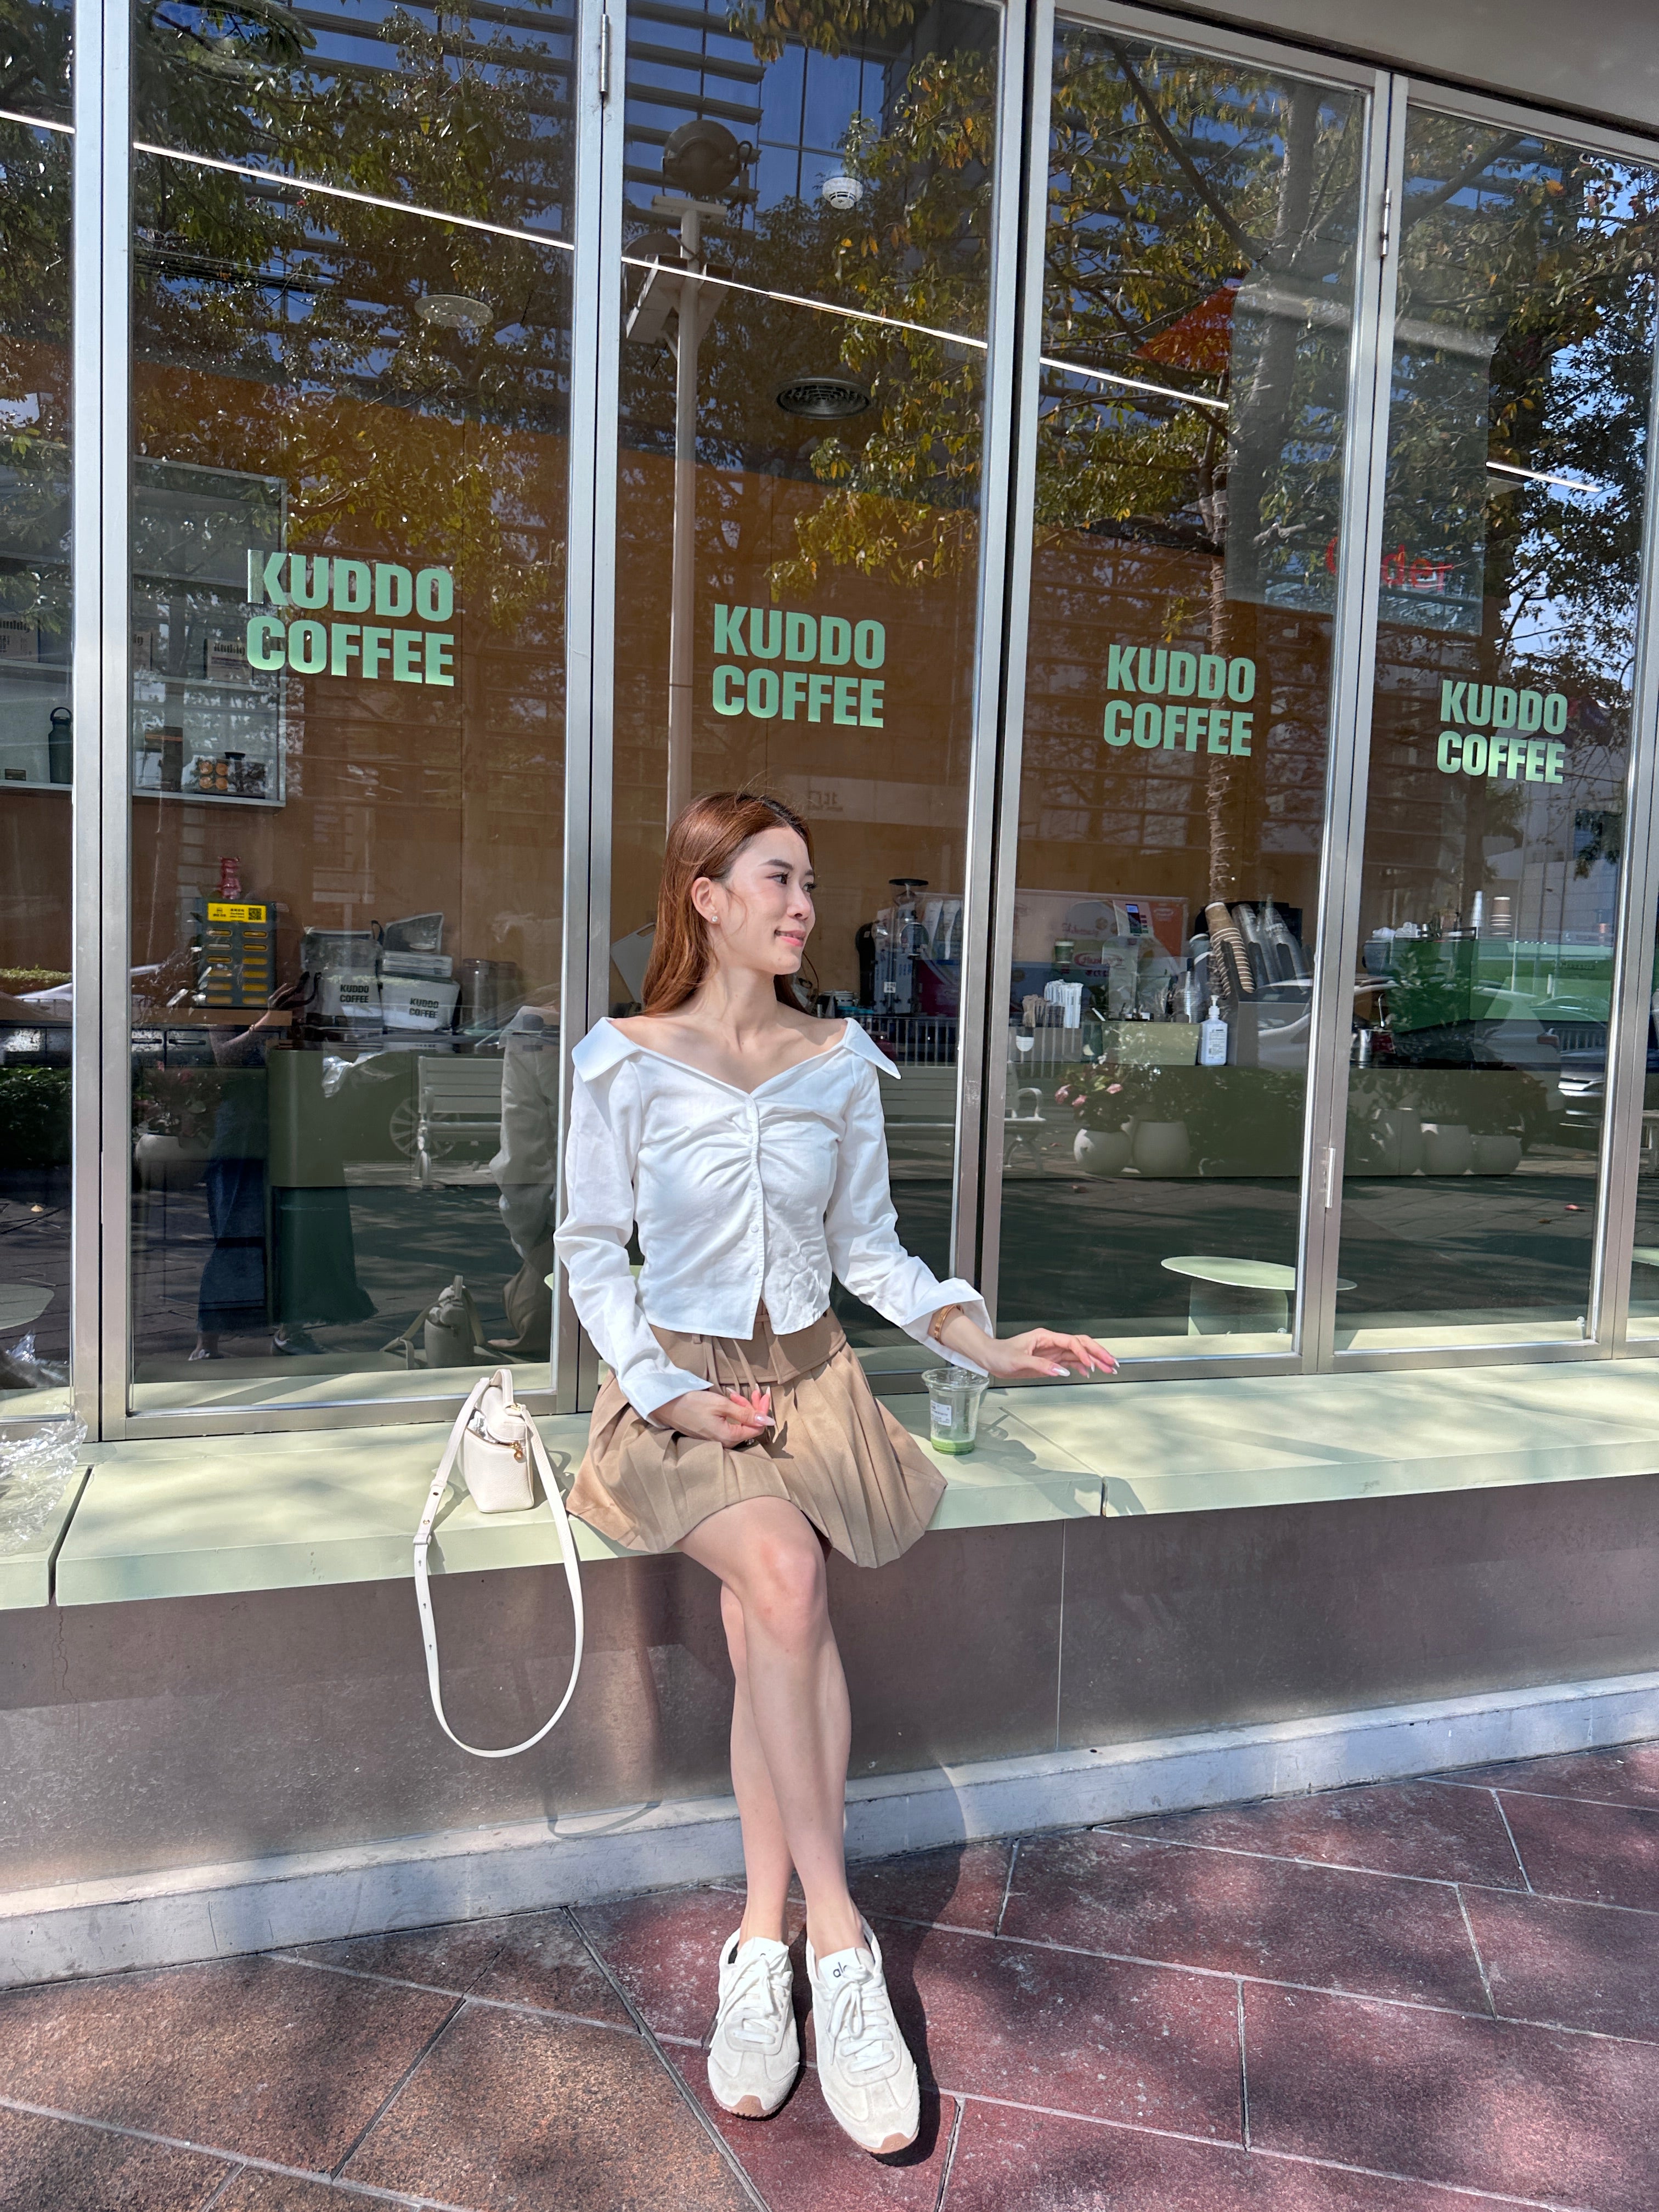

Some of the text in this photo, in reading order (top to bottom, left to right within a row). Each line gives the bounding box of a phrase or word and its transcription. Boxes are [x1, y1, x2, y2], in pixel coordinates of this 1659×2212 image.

[247, 549, 453, 621] KUDDO
[1325, 535, 1454, 591] der
[247, 615, 454, 685] COFFEE
[714, 604, 885, 669] KUDDO
[713, 665, 884, 727] COFFEE
[1107, 645, 1256, 702] KUDDO
[1104, 700, 1254, 756] COFFEE
[1441, 680, 1567, 734] KUDDO
[1437, 730, 1565, 783] COFFEE
[340, 984, 369, 993] KUDDO
[340, 995, 369, 1003] COFFEE
[409, 1008, 438, 1018] COFFEE
[410, 997, 439, 1008] KUDDO
